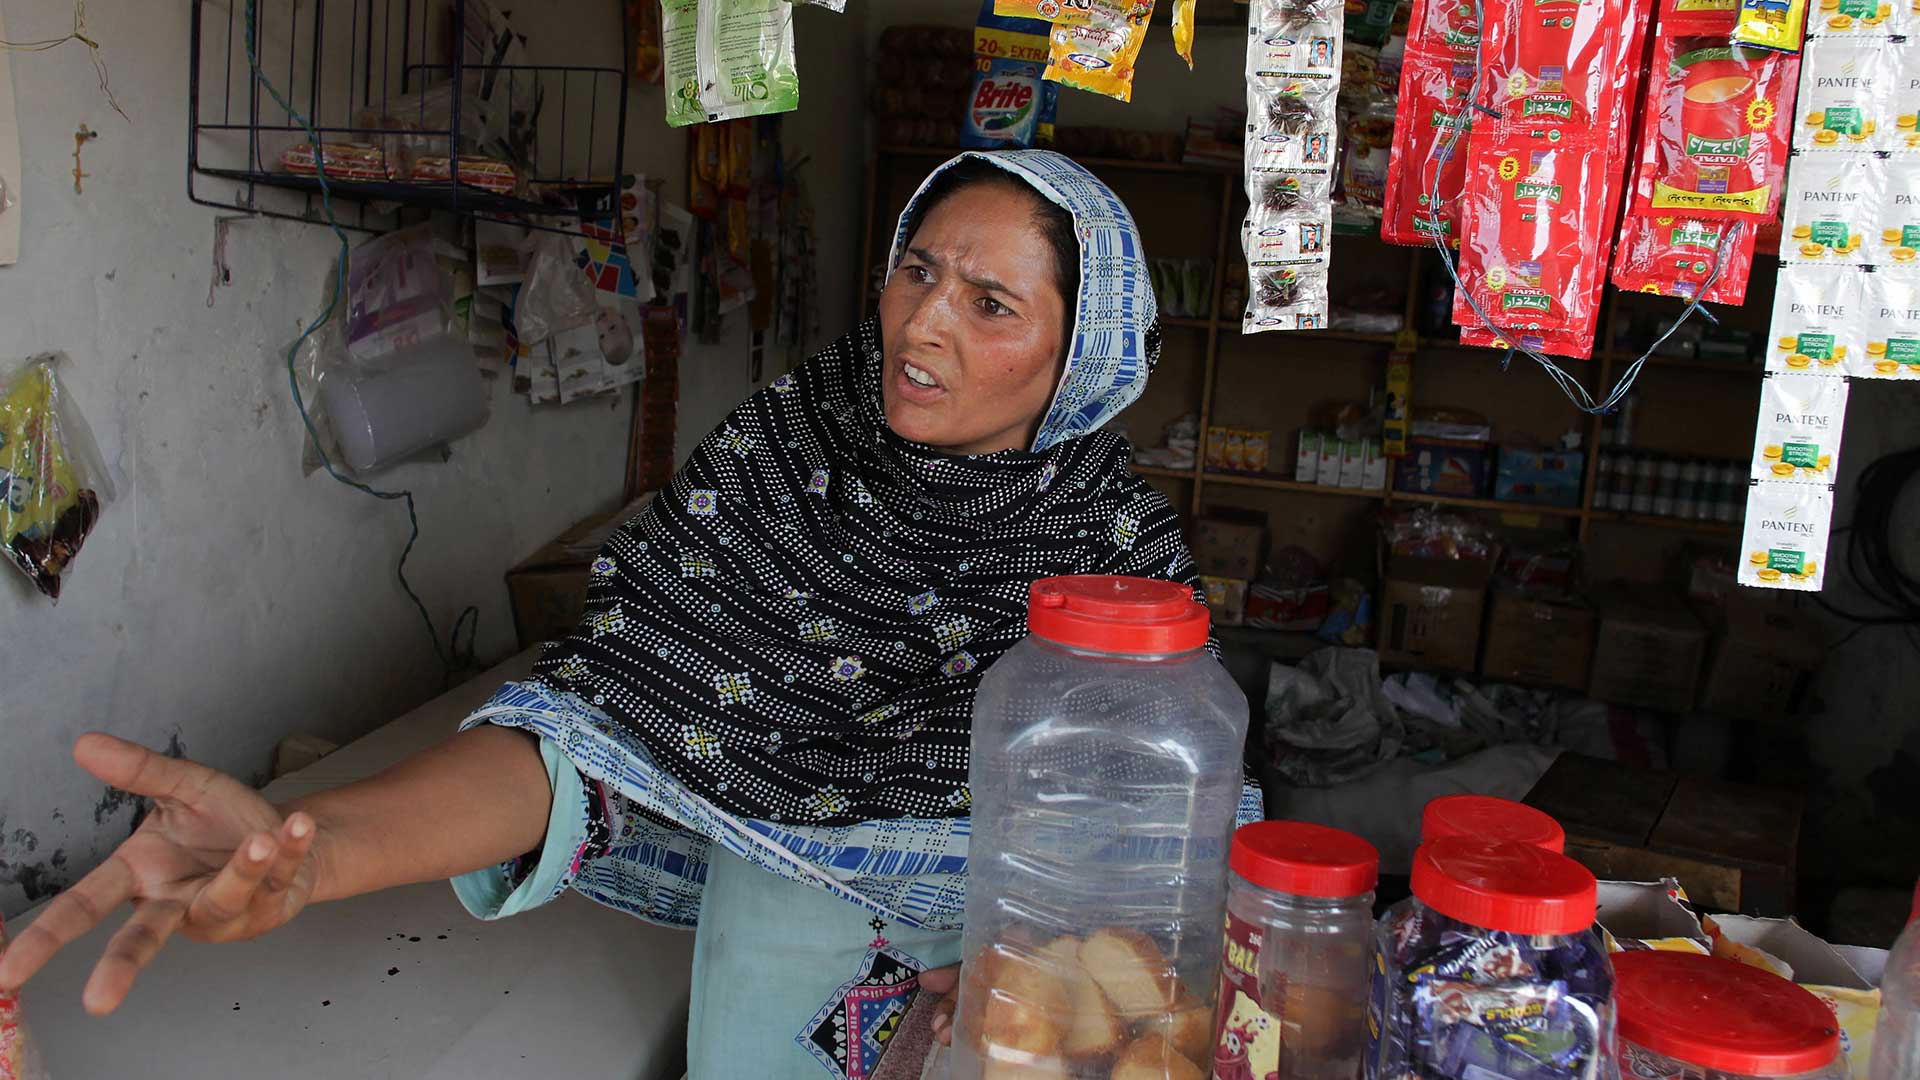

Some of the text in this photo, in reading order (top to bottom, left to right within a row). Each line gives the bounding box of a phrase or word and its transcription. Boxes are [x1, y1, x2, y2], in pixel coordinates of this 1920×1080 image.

[1009, 45, 1050, 62] EXTRA
[1512, 78, 1523, 89] 5
[1817, 77, 1872, 88] PANTENE
[731, 81, 769, 101] Olla
[974, 80, 1033, 109] Brite
[1752, 107, 1768, 124] 5
[1695, 155, 1736, 163] TAPAL
[1503, 161, 1515, 173] 5
[1804, 191, 1860, 202] PANTENE
[1491, 270, 1503, 281] 5
[1880, 308, 1920, 320] PANTE
[1776, 413, 1829, 425] PANTENE
[1761, 520, 1815, 533] PANTENE
